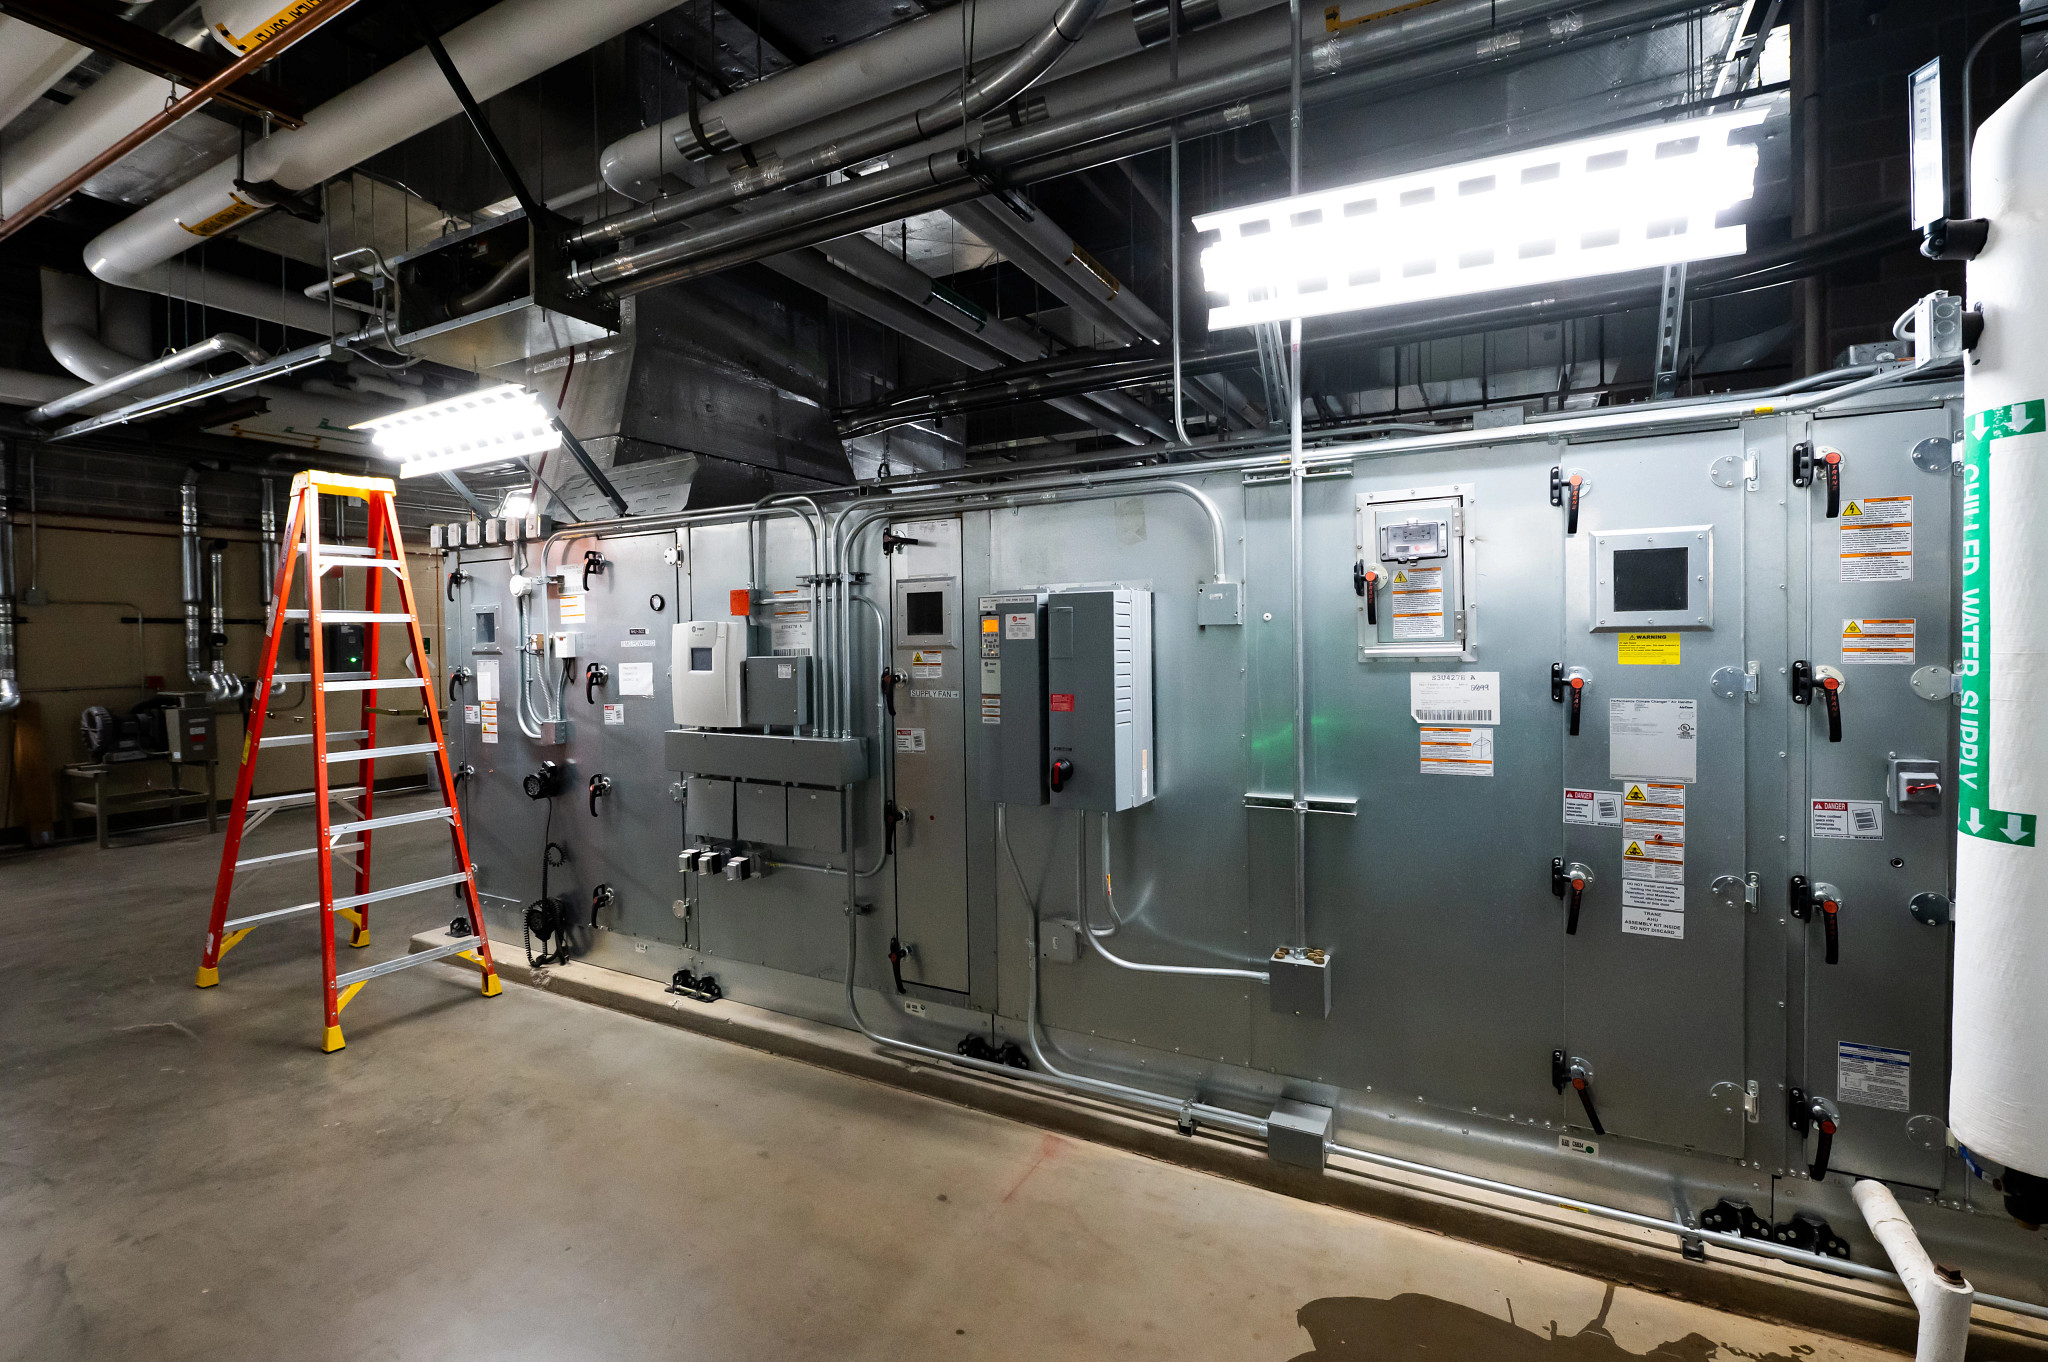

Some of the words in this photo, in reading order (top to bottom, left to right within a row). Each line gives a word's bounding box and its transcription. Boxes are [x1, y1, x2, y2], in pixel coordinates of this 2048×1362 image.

[1963, 464, 1980, 576] CHILLED
[1961, 588, 1980, 676] WATER
[1959, 690, 1980, 790] SUPPLY
[1824, 802, 1846, 810] DANGER
